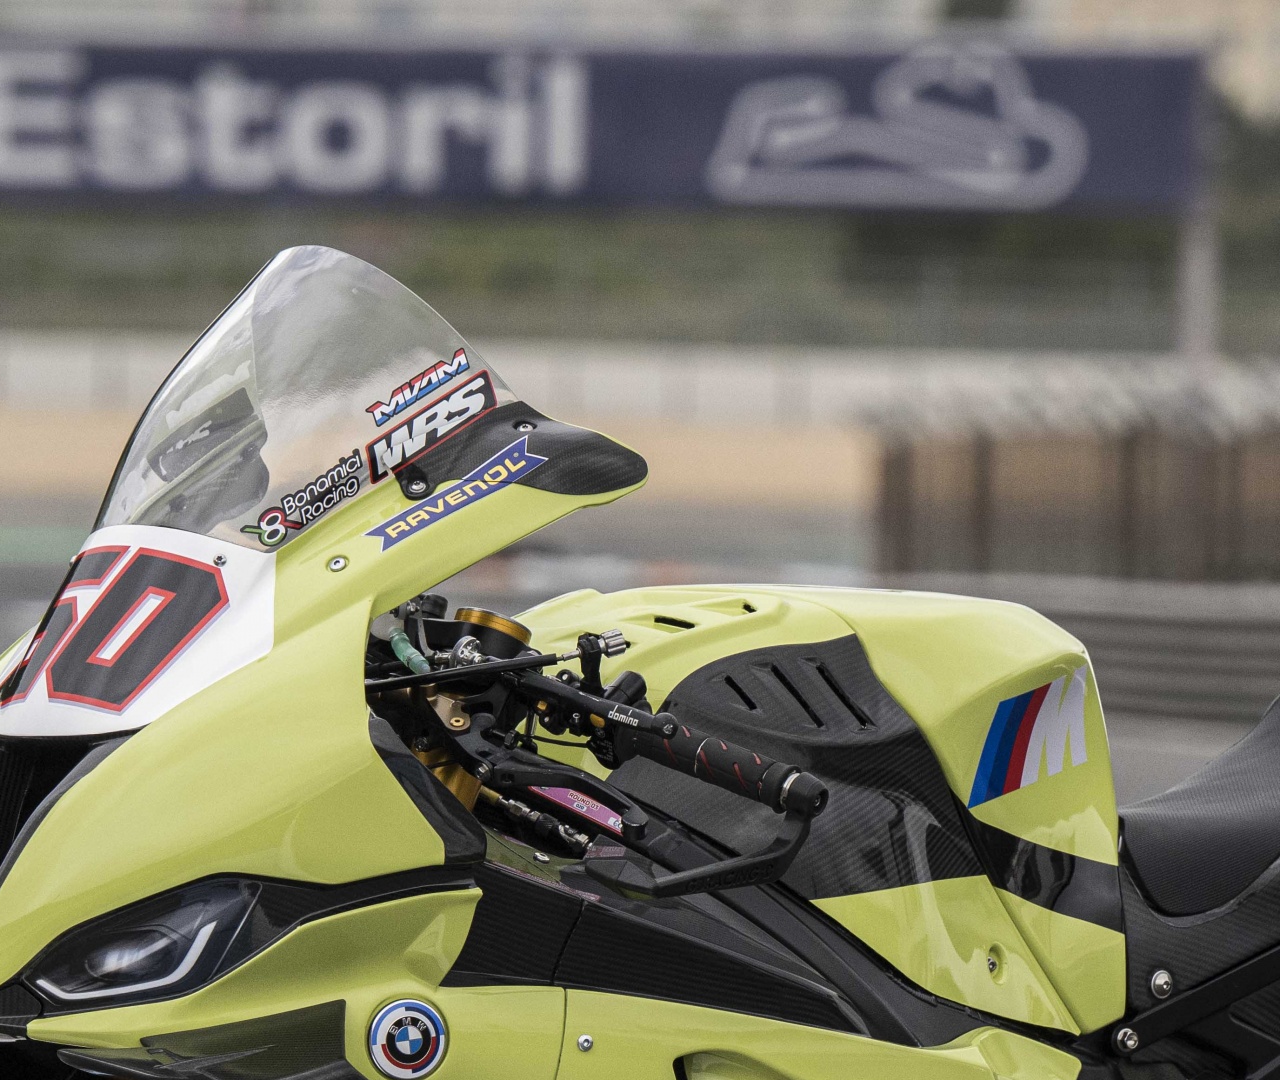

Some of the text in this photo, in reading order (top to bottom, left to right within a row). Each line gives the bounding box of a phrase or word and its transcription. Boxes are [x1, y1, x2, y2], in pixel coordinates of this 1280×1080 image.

[373, 376, 485, 476] WRS
[283, 450, 361, 516] Bonamici
[301, 478, 359, 524] Racing
[384, 458, 527, 538] RAVENOL
[608, 705, 639, 727] domino
[569, 792, 590, 806] ROUND
[388, 1017, 427, 1036] BMW
